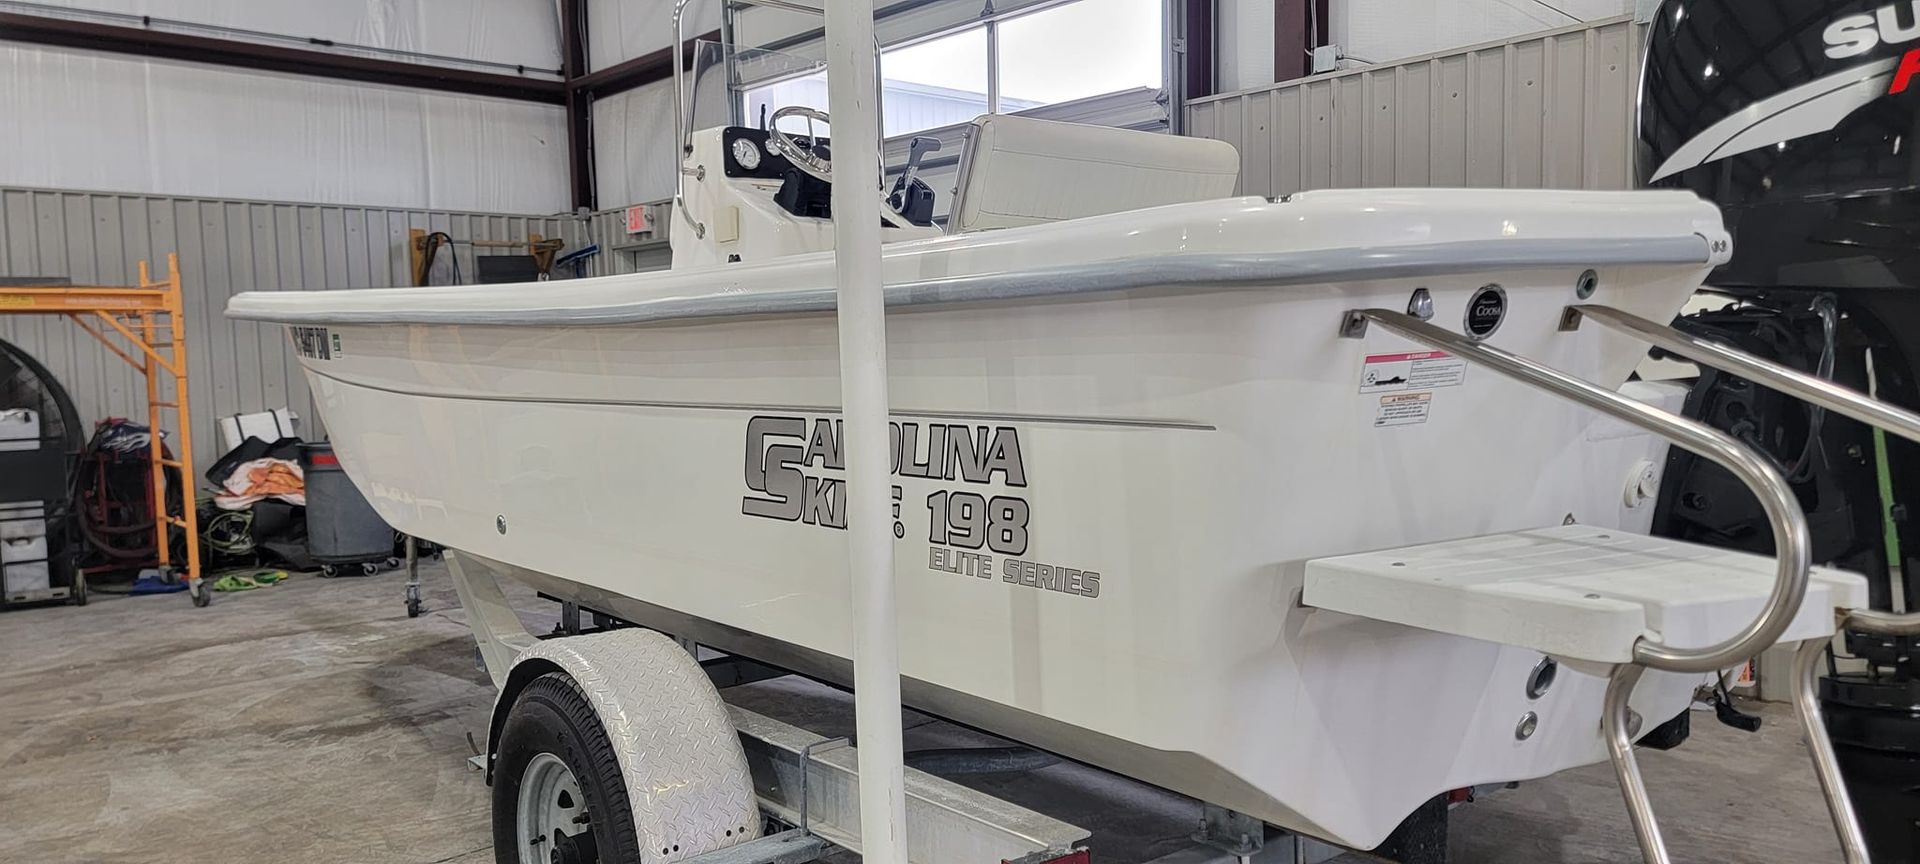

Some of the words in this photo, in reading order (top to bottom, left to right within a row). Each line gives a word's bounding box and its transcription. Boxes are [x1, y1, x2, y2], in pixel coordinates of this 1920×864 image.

[745, 416, 1027, 492] CALINA
[742, 444, 903, 531] SKI
[927, 490, 1030, 556] 198
[928, 546, 993, 580] ELITE
[1002, 558, 1101, 599] SERIES
